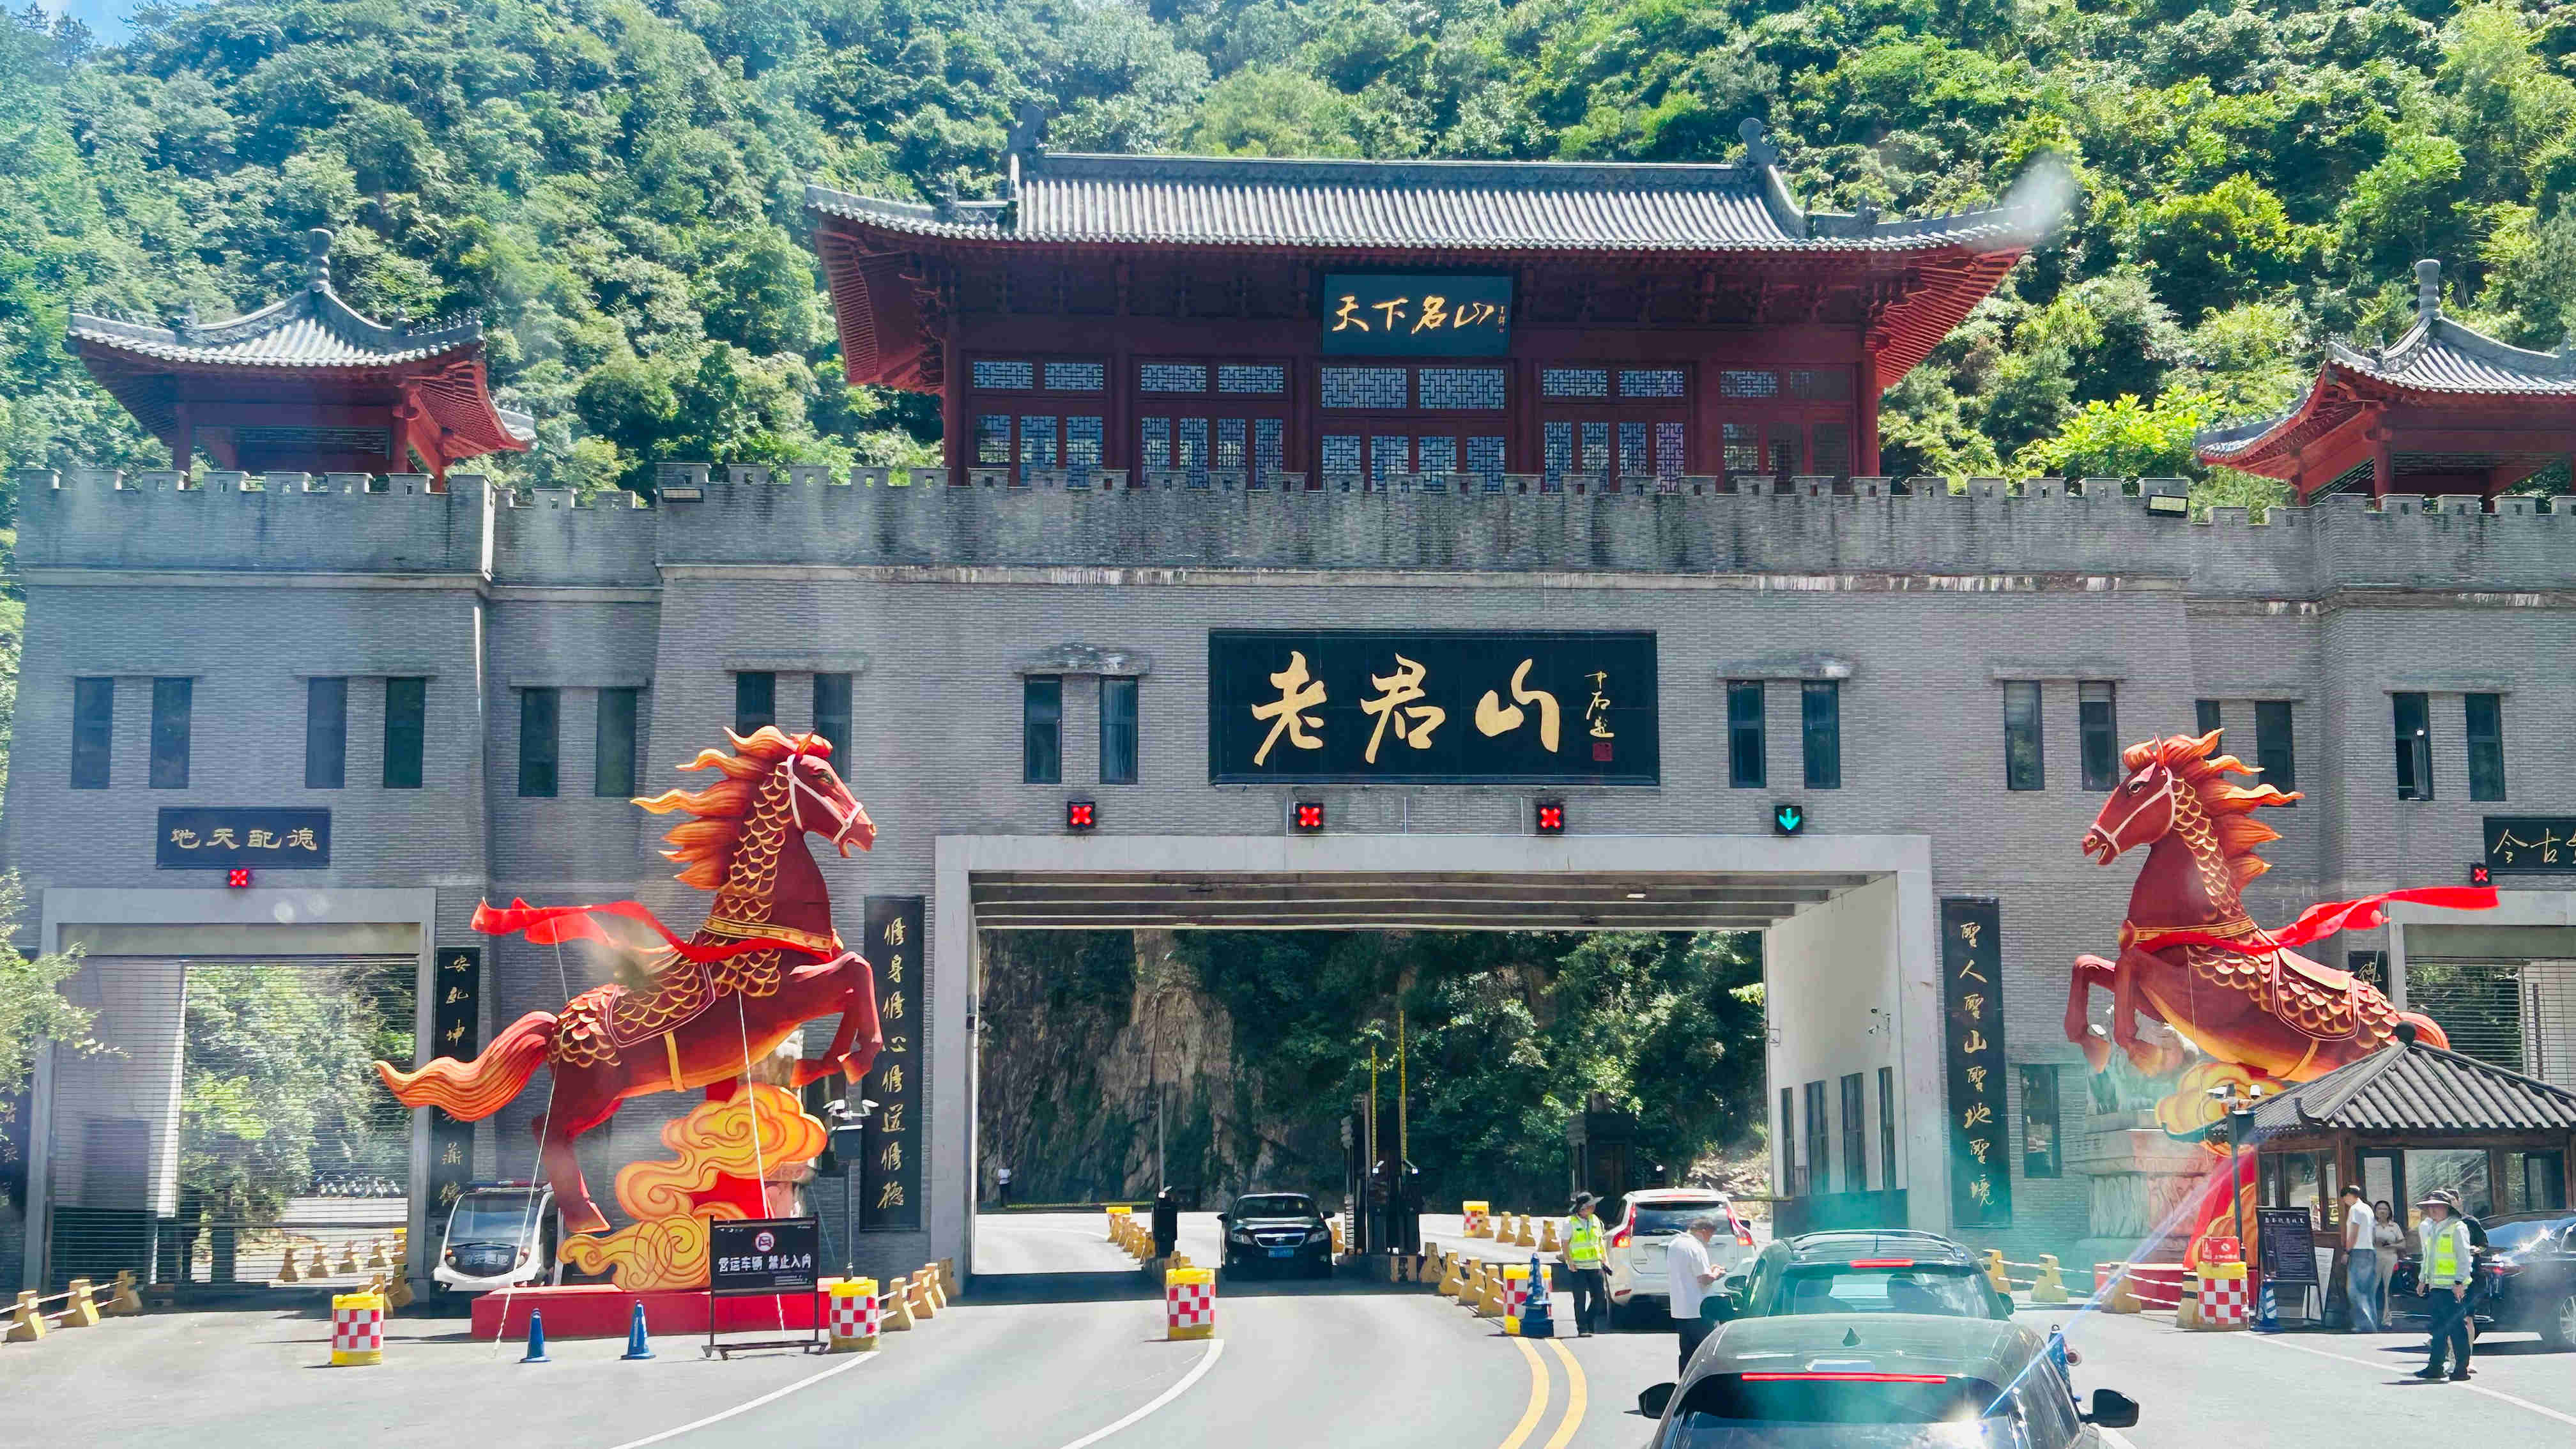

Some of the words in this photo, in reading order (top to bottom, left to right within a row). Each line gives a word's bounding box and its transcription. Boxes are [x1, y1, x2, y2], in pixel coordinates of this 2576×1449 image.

[1332, 295, 1494, 334] 天下名山
[1251, 650, 1560, 766] 老君山
